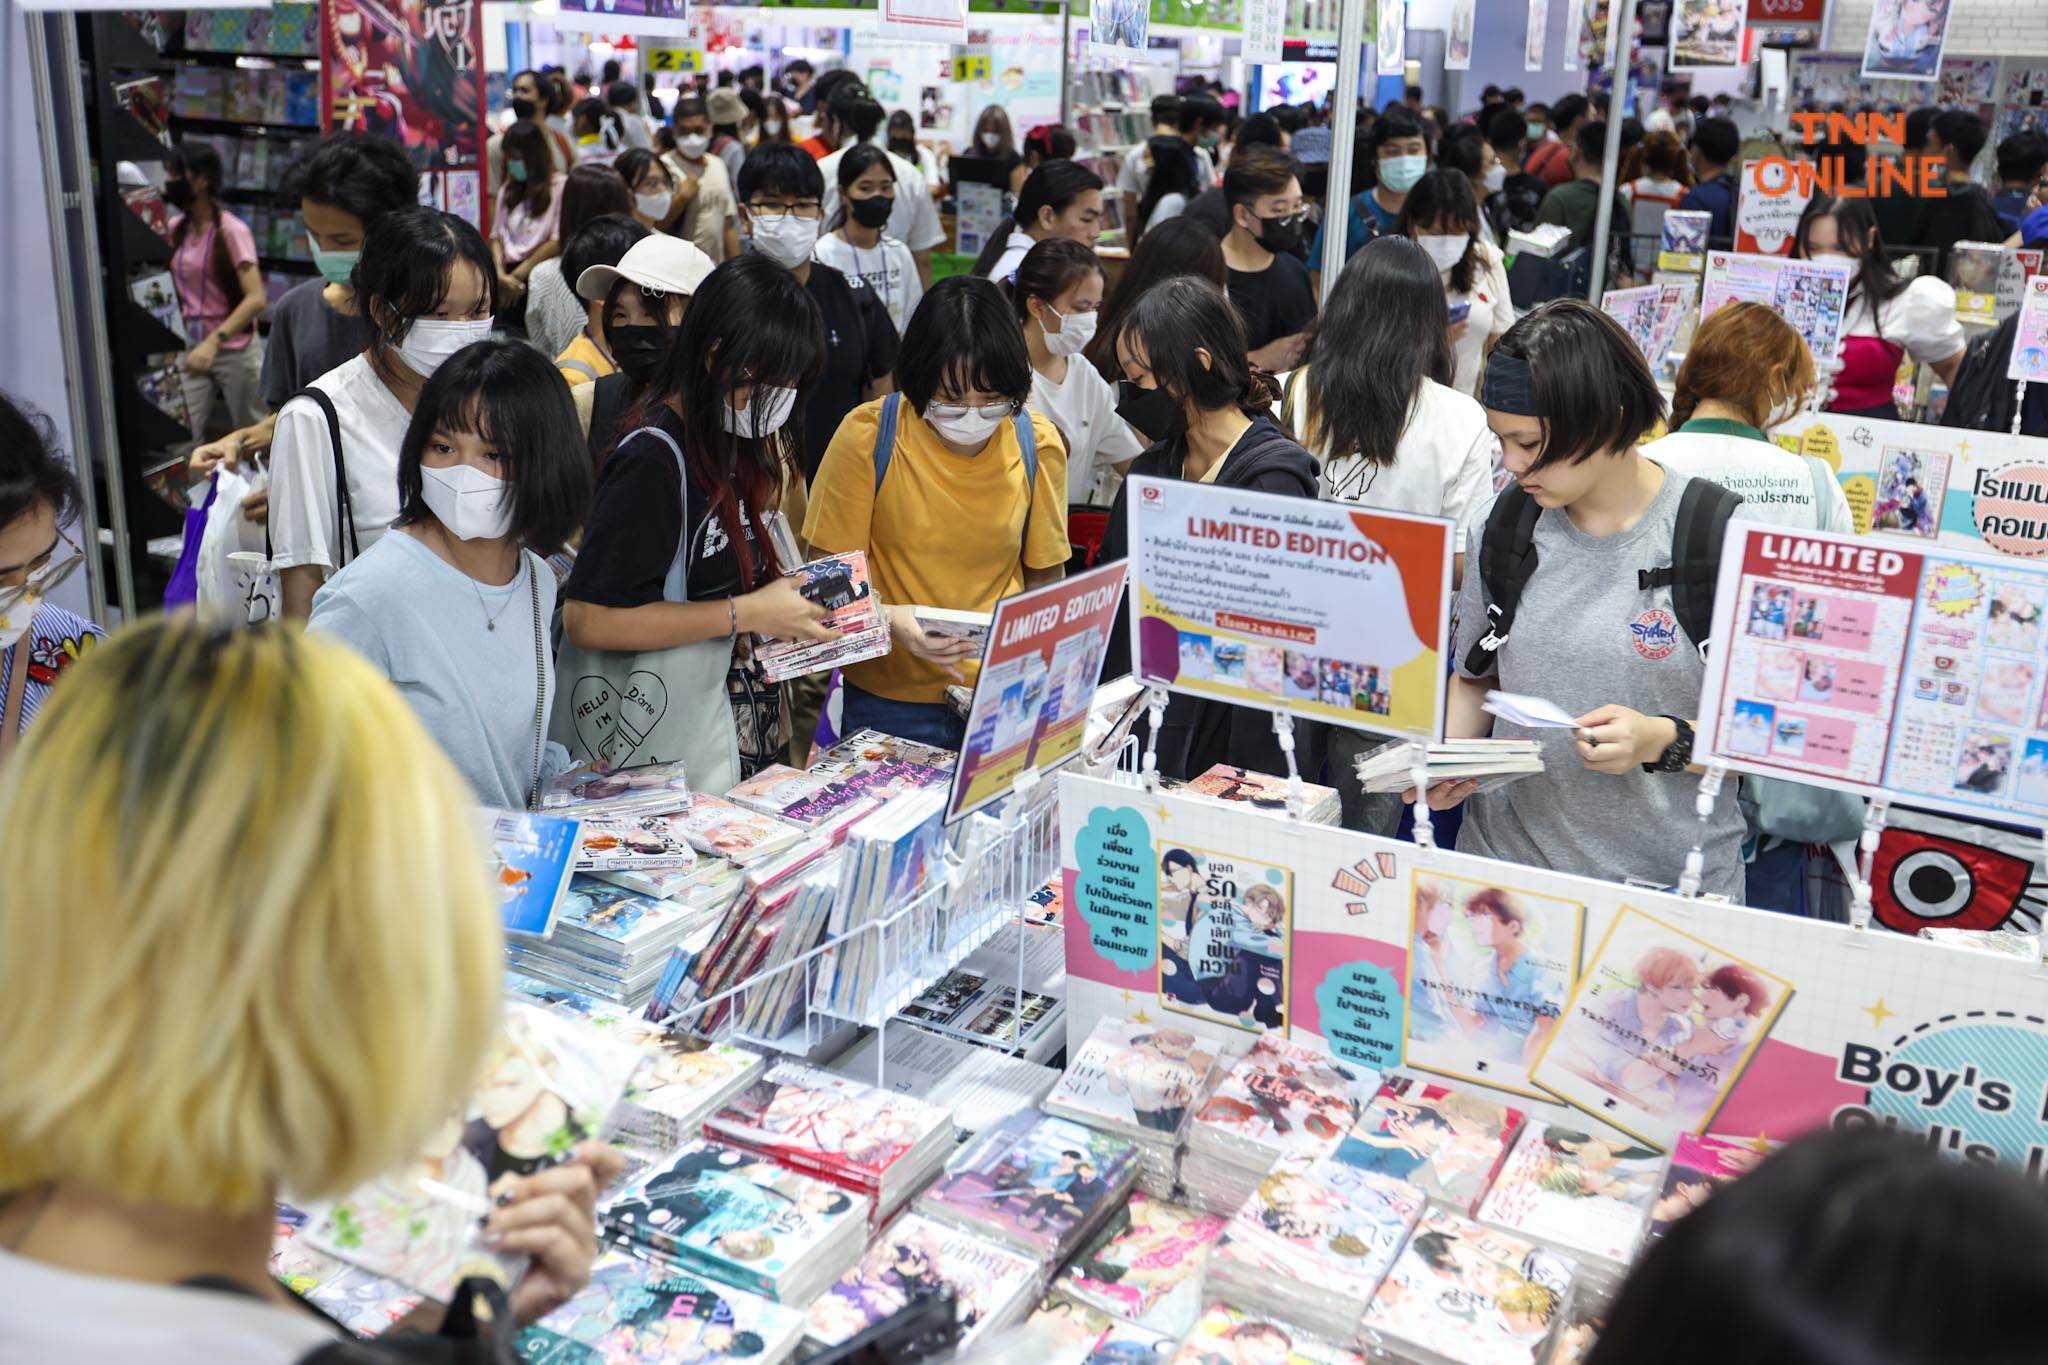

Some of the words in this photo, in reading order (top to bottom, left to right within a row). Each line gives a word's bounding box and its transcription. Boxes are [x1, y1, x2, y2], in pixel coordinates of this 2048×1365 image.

[655, 52, 673, 68] 2
[957, 61, 967, 77] 1
[1982, 515, 2048, 541] คอเม
[1187, 517, 1281, 550] LIMITED
[1286, 532, 1389, 566] EDITION
[1760, 535, 1905, 576] LIMITED
[1001, 604, 1059, 648] LIMITED
[1063, 583, 1117, 624] EDITION
[1630, 620, 1678, 643] SHARK
[577, 690, 609, 719] HELLO
[595, 712, 612, 730] I'M
[1107, 822, 1128, 838] เมื่อ
[1102, 839, 1133, 856] เพื่อน
[1097, 854, 1140, 873] ร่วมงาน
[1208, 862, 1234, 873] บอก
[1102, 874, 1135, 889] เอาฉัน
[1206, 873, 1237, 898] รัก
[1085, 883, 1153, 910] ไปเป็นตัวเอก
[1134, 913, 1149, 926] BL
[1208, 913, 1234, 926] จะได้
[1111, 925, 1128, 938] สุด
[1093, 934, 1148, 958] ร้อนแรง!!!
[1200, 958, 1242, 976] หวาน
[1352, 972, 1377, 985] นาย
[1341, 985, 1387, 1003] ชอบฉัน
[1336, 995, 1391, 1021] ไปจนกว่า
[1353, 1016, 1373, 1031] ฉัน
[1331, 1028, 1394, 1051] จะชอบนาย
[1340, 1045, 1383, 1064] แล้วกัน
[1841, 1042, 2012, 1112] Boy's
